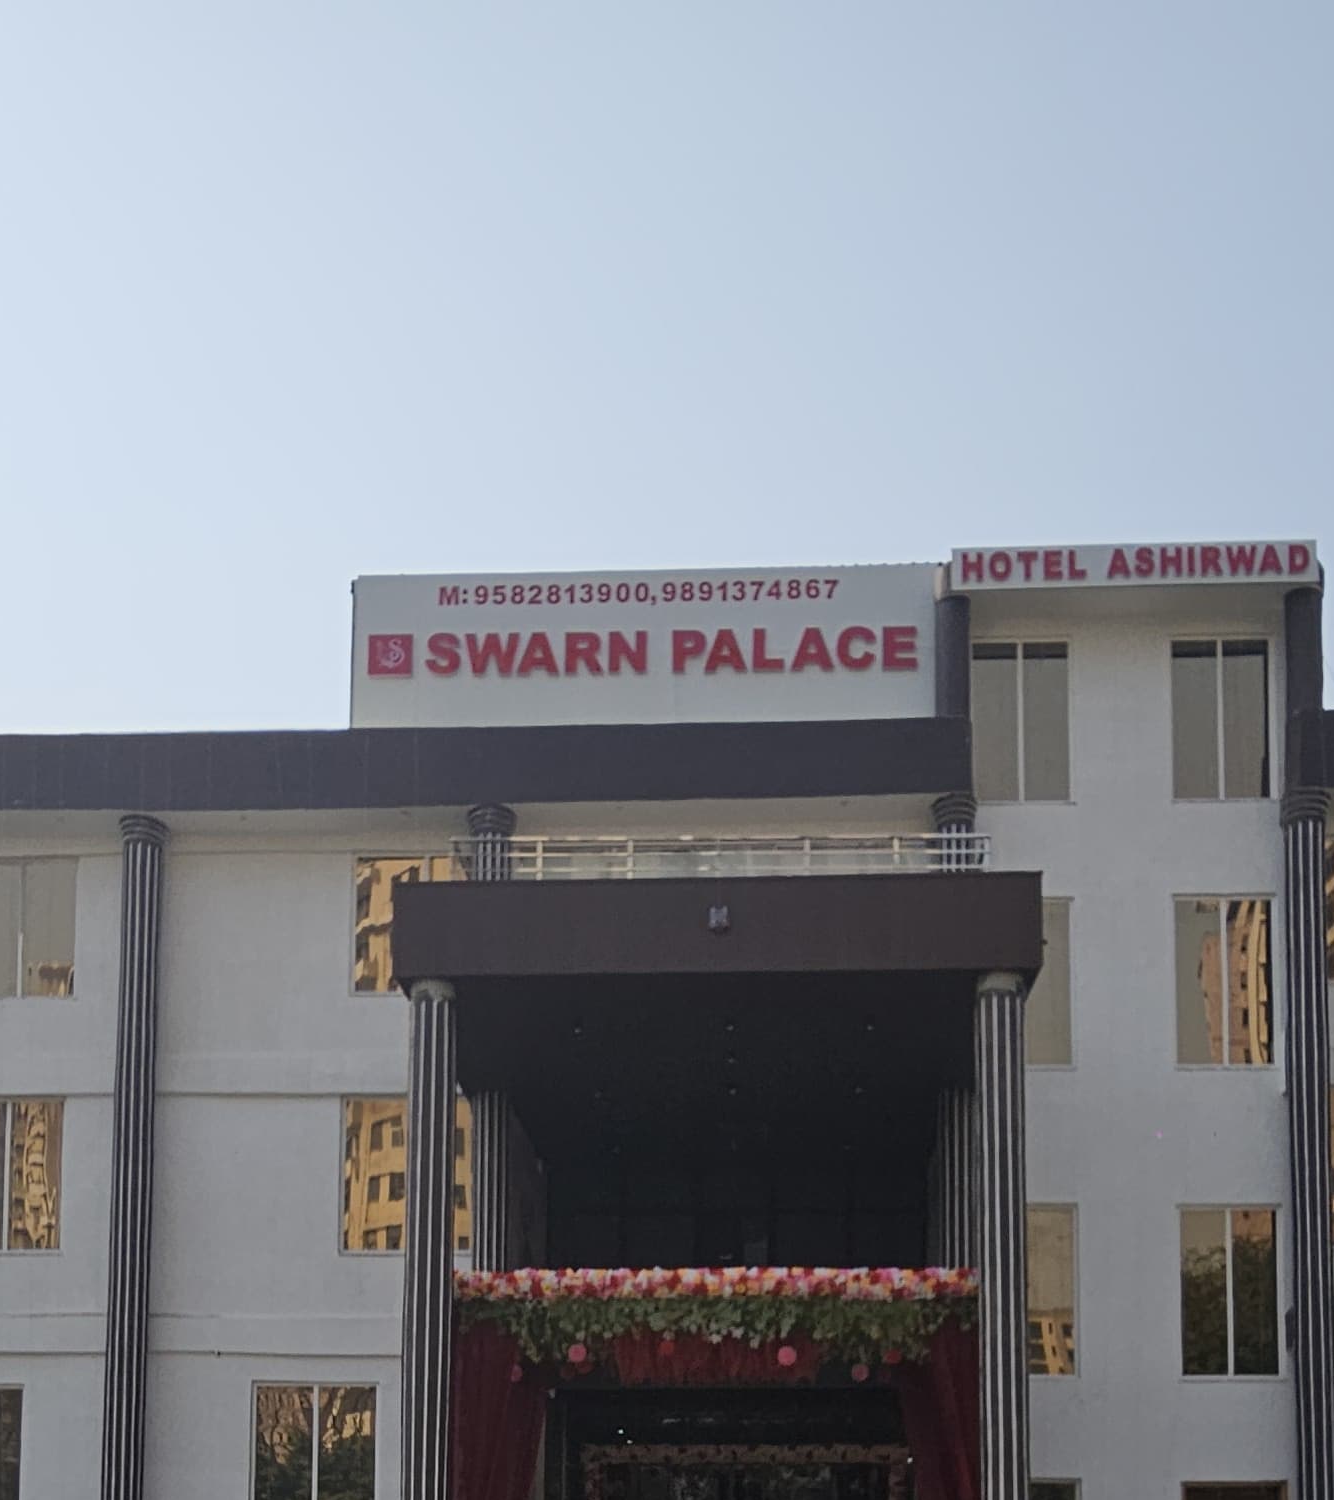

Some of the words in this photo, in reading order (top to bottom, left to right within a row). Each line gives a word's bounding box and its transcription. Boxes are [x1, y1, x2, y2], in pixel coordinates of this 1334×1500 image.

[961, 550, 1087, 583] HOTEL
[1107, 543, 1311, 579] ASHIRWAD
[438, 579, 840, 606] M:9582813900,9891374867
[425, 631, 648, 676] SWARN
[671, 626, 917, 674] PALACE
